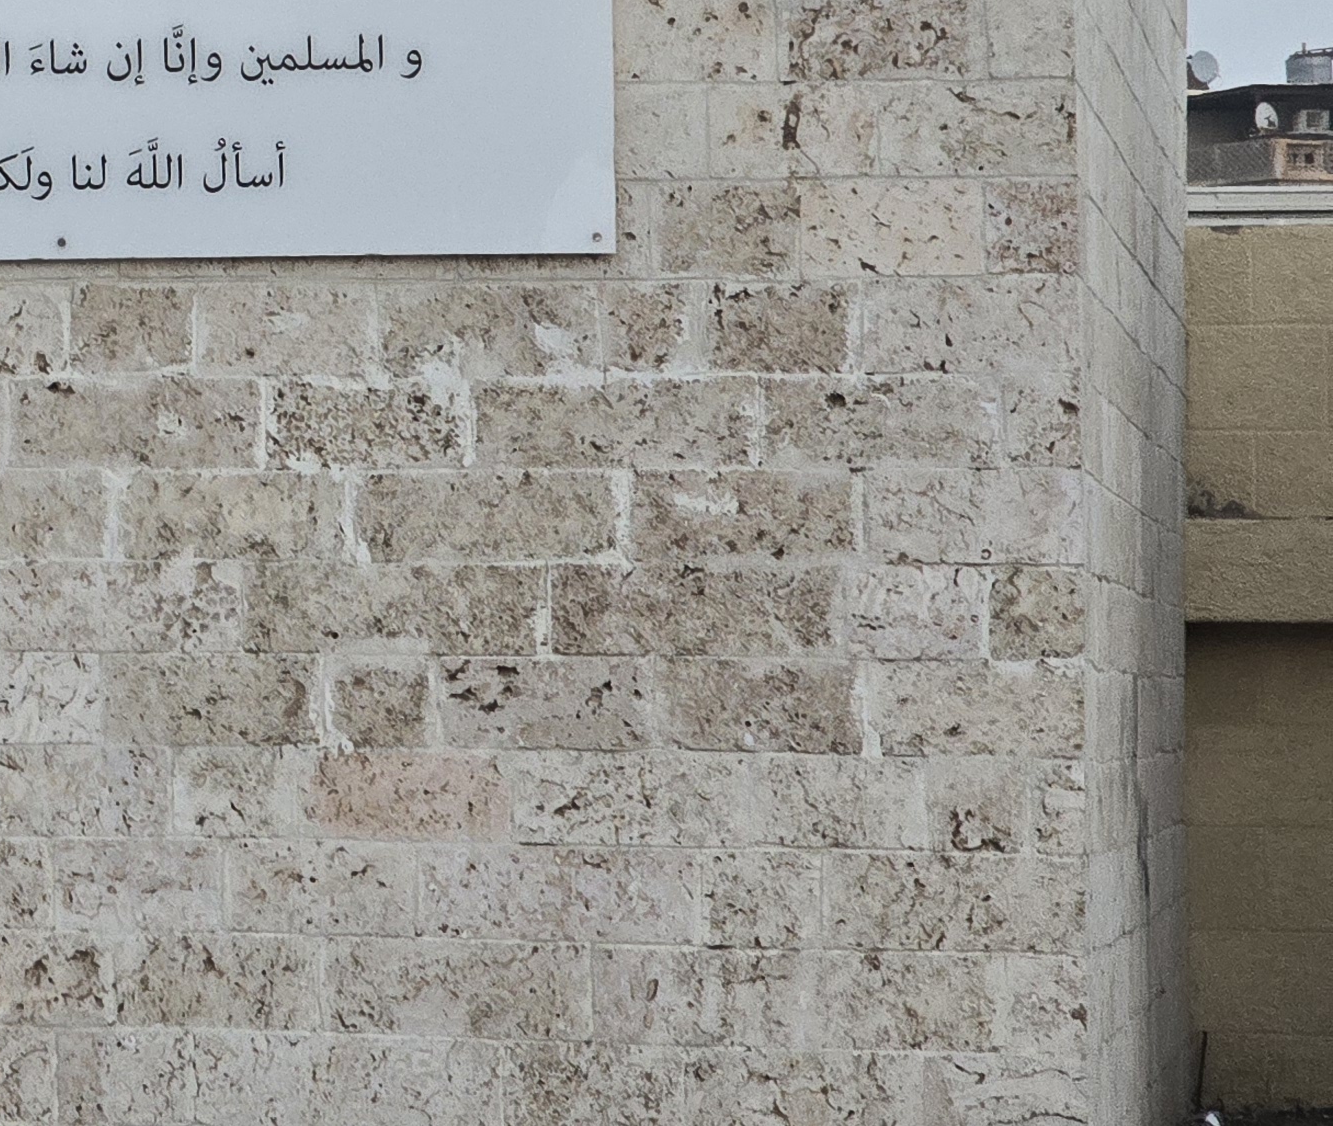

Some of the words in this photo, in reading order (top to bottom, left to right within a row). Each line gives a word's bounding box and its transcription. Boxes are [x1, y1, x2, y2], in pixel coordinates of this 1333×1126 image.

[106, 38, 145, 86] إن
[240, 33, 384, 85] المسلمين
[400, 49, 423, 79] و
[71, 153, 107, 191] لنا
